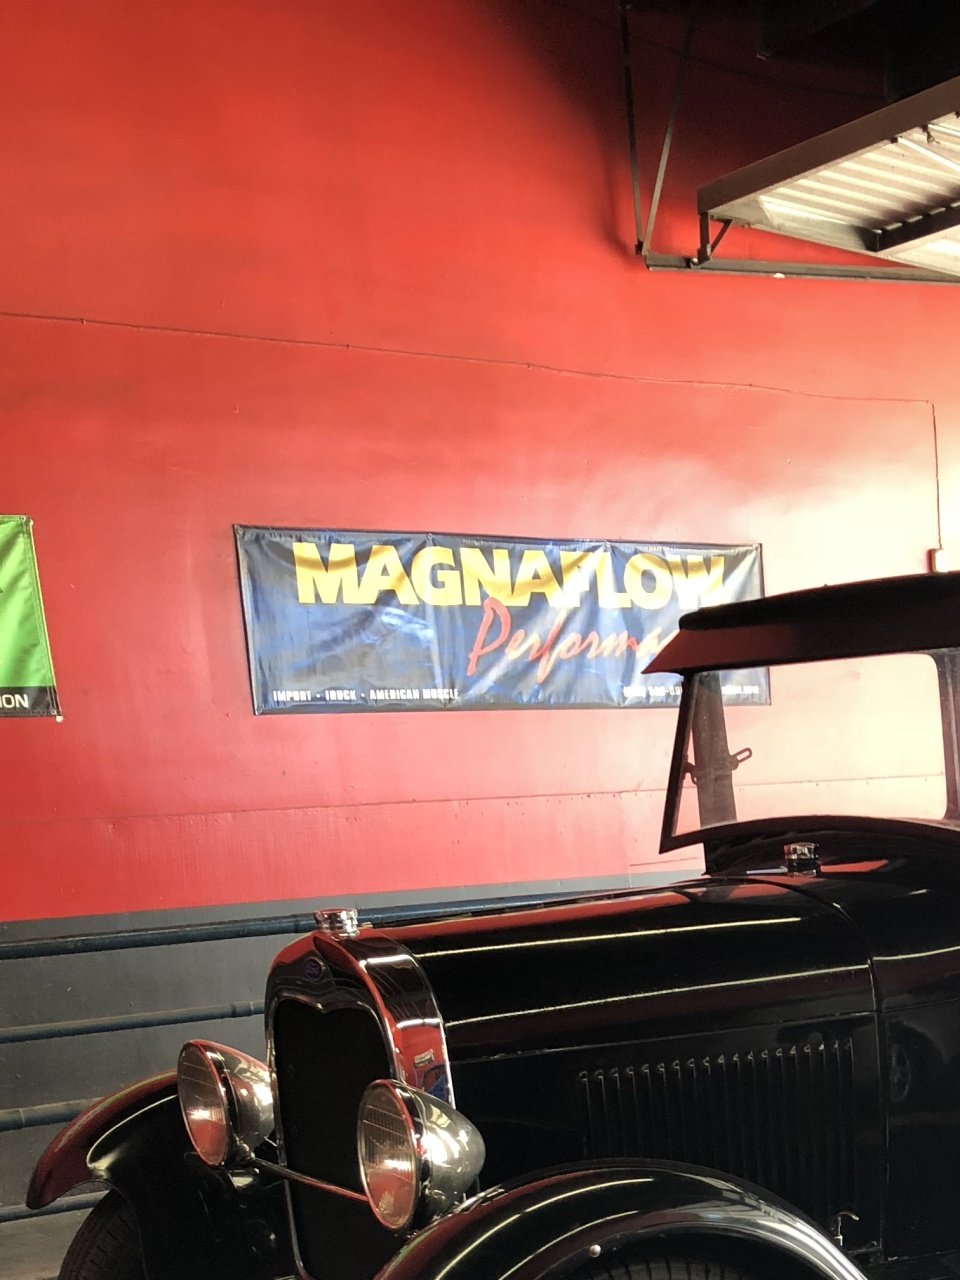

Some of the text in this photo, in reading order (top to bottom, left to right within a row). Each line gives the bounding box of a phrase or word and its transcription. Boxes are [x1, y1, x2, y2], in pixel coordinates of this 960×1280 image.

[293, 541, 725, 609] MAGNAFLOW
[272, 688, 460, 702] IMPORT TRUCK AMERICAN MUSCLE
